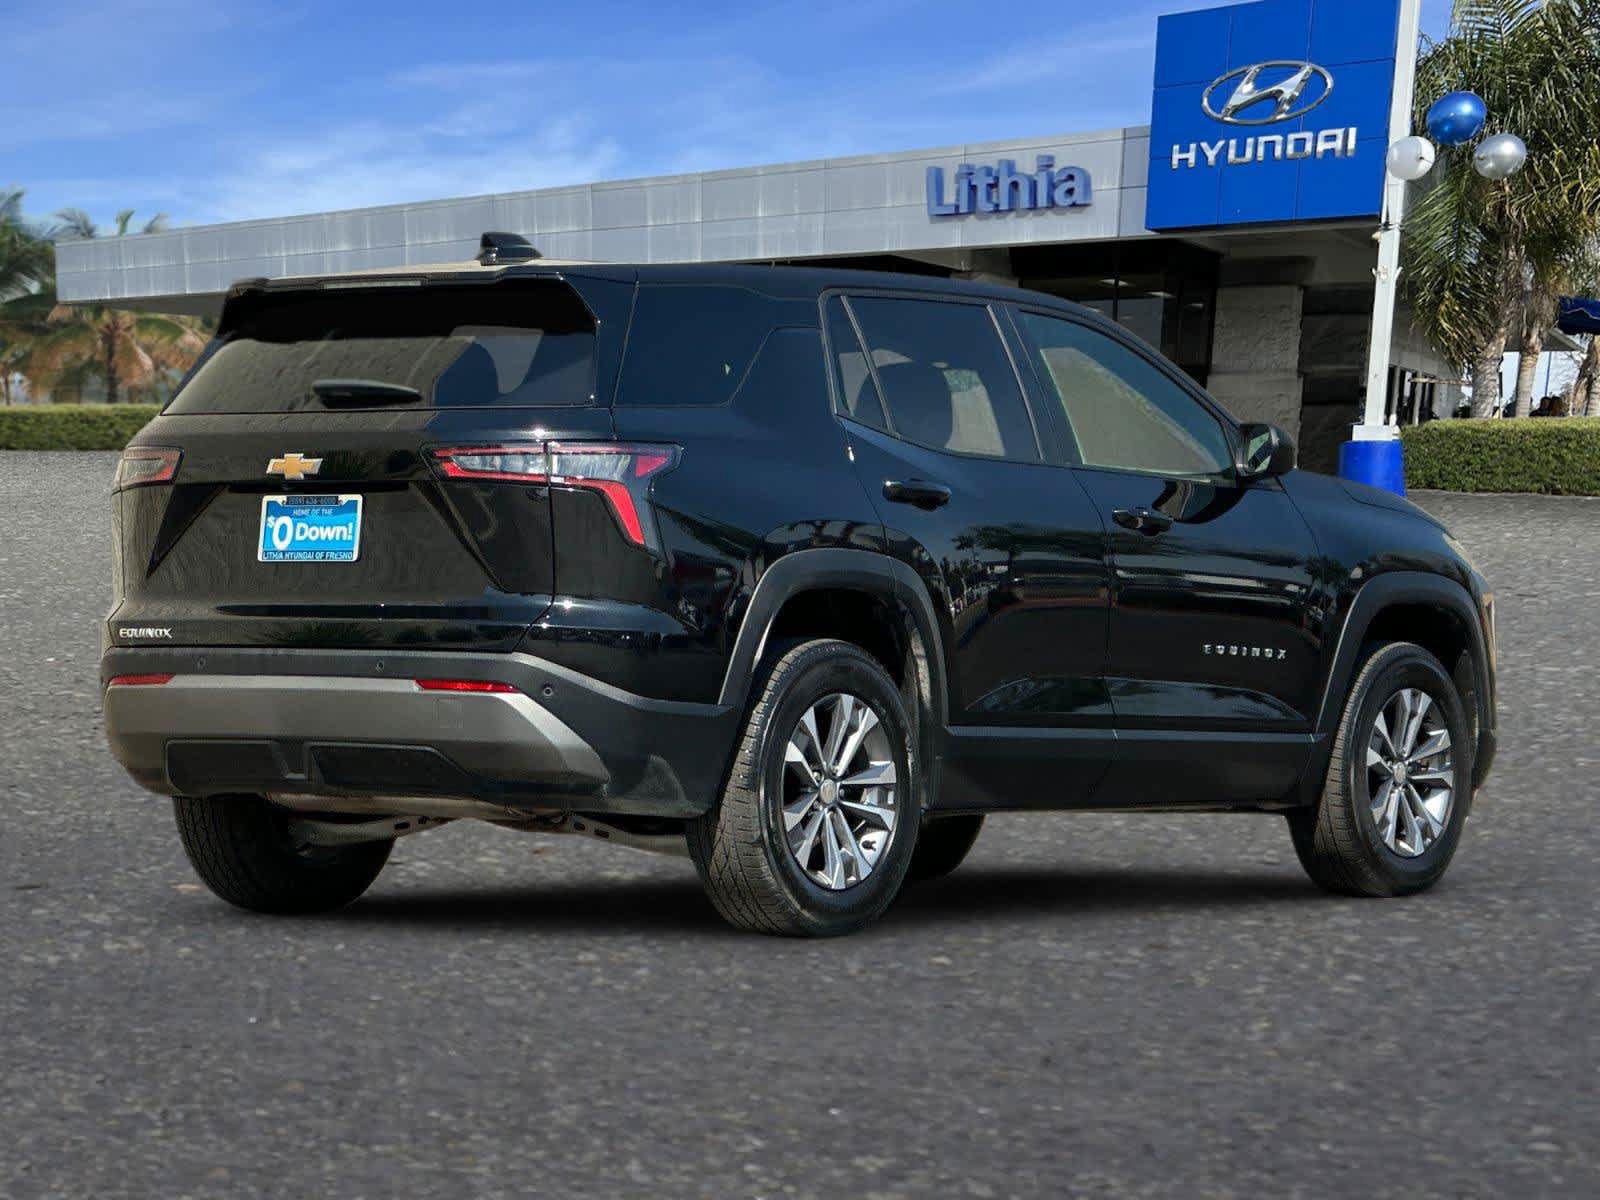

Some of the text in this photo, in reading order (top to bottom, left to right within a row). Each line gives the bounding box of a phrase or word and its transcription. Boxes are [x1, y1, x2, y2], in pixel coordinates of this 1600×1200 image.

[1171, 127, 1357, 169] HYUNDAI
[926, 154, 1093, 217] Lithia
[293, 508, 333, 516] HOME OF THE
[295, 522, 354, 541] Down!
[284, 551, 314, 560] HYUNDAI
[315, 552, 324, 560] OF
[325, 552, 353, 560] FRESNO
[119, 627, 172, 639] EQUINOX
[1203, 644, 1287, 660] EQUINOX
